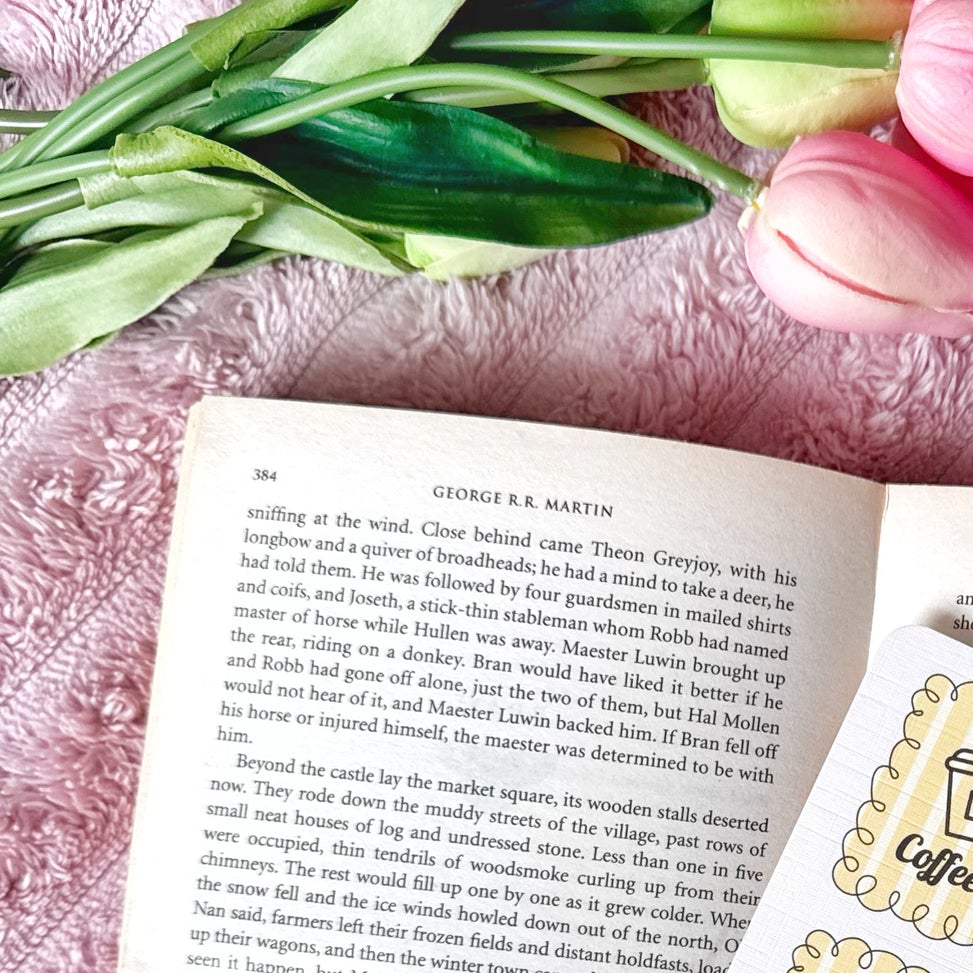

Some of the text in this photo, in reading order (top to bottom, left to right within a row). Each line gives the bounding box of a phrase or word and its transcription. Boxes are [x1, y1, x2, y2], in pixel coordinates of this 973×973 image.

[252, 468, 279, 484] 384
[432, 485, 613, 518] GEORGE R.R. MARTIN
[247, 505, 798, 588] sniffing at the wind. Close behind came Theon Greyjoy, with his
[231, 626, 784, 711] the rear, riding on a donkey. Bran would have liked it better if he
